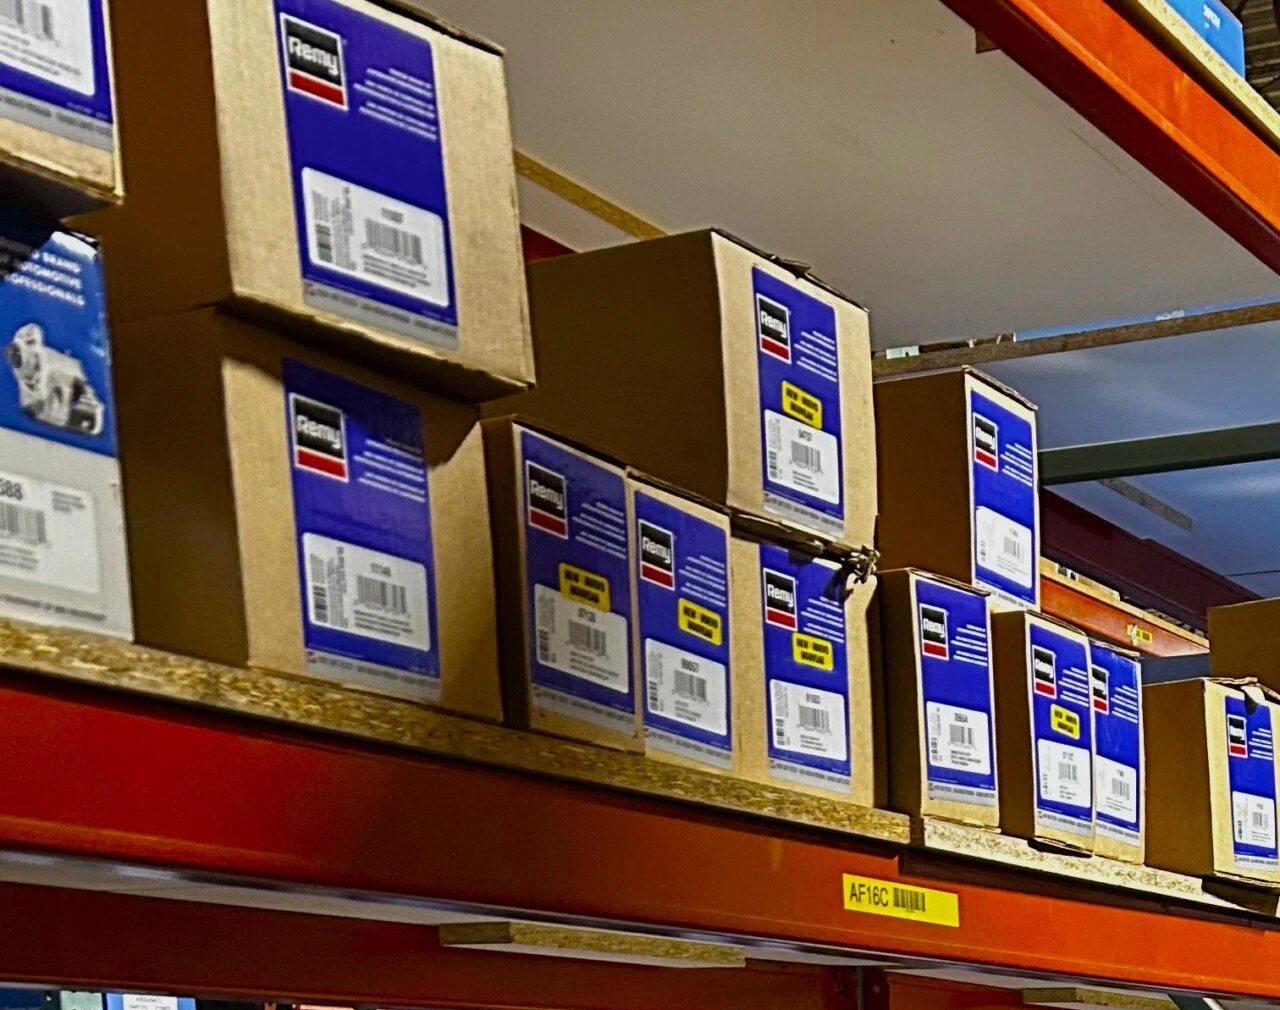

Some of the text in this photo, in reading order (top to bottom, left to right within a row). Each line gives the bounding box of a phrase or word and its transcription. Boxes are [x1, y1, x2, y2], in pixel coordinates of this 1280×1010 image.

[288, 35, 338, 76] Remy
[761, 310, 786, 339] Remy
[296, 415, 341, 449] Remy
[531, 480, 562, 510] Remy
[642, 536, 670, 563] Remy
[767, 584, 793, 608] Remy
[850, 882, 889, 907] AF16C
